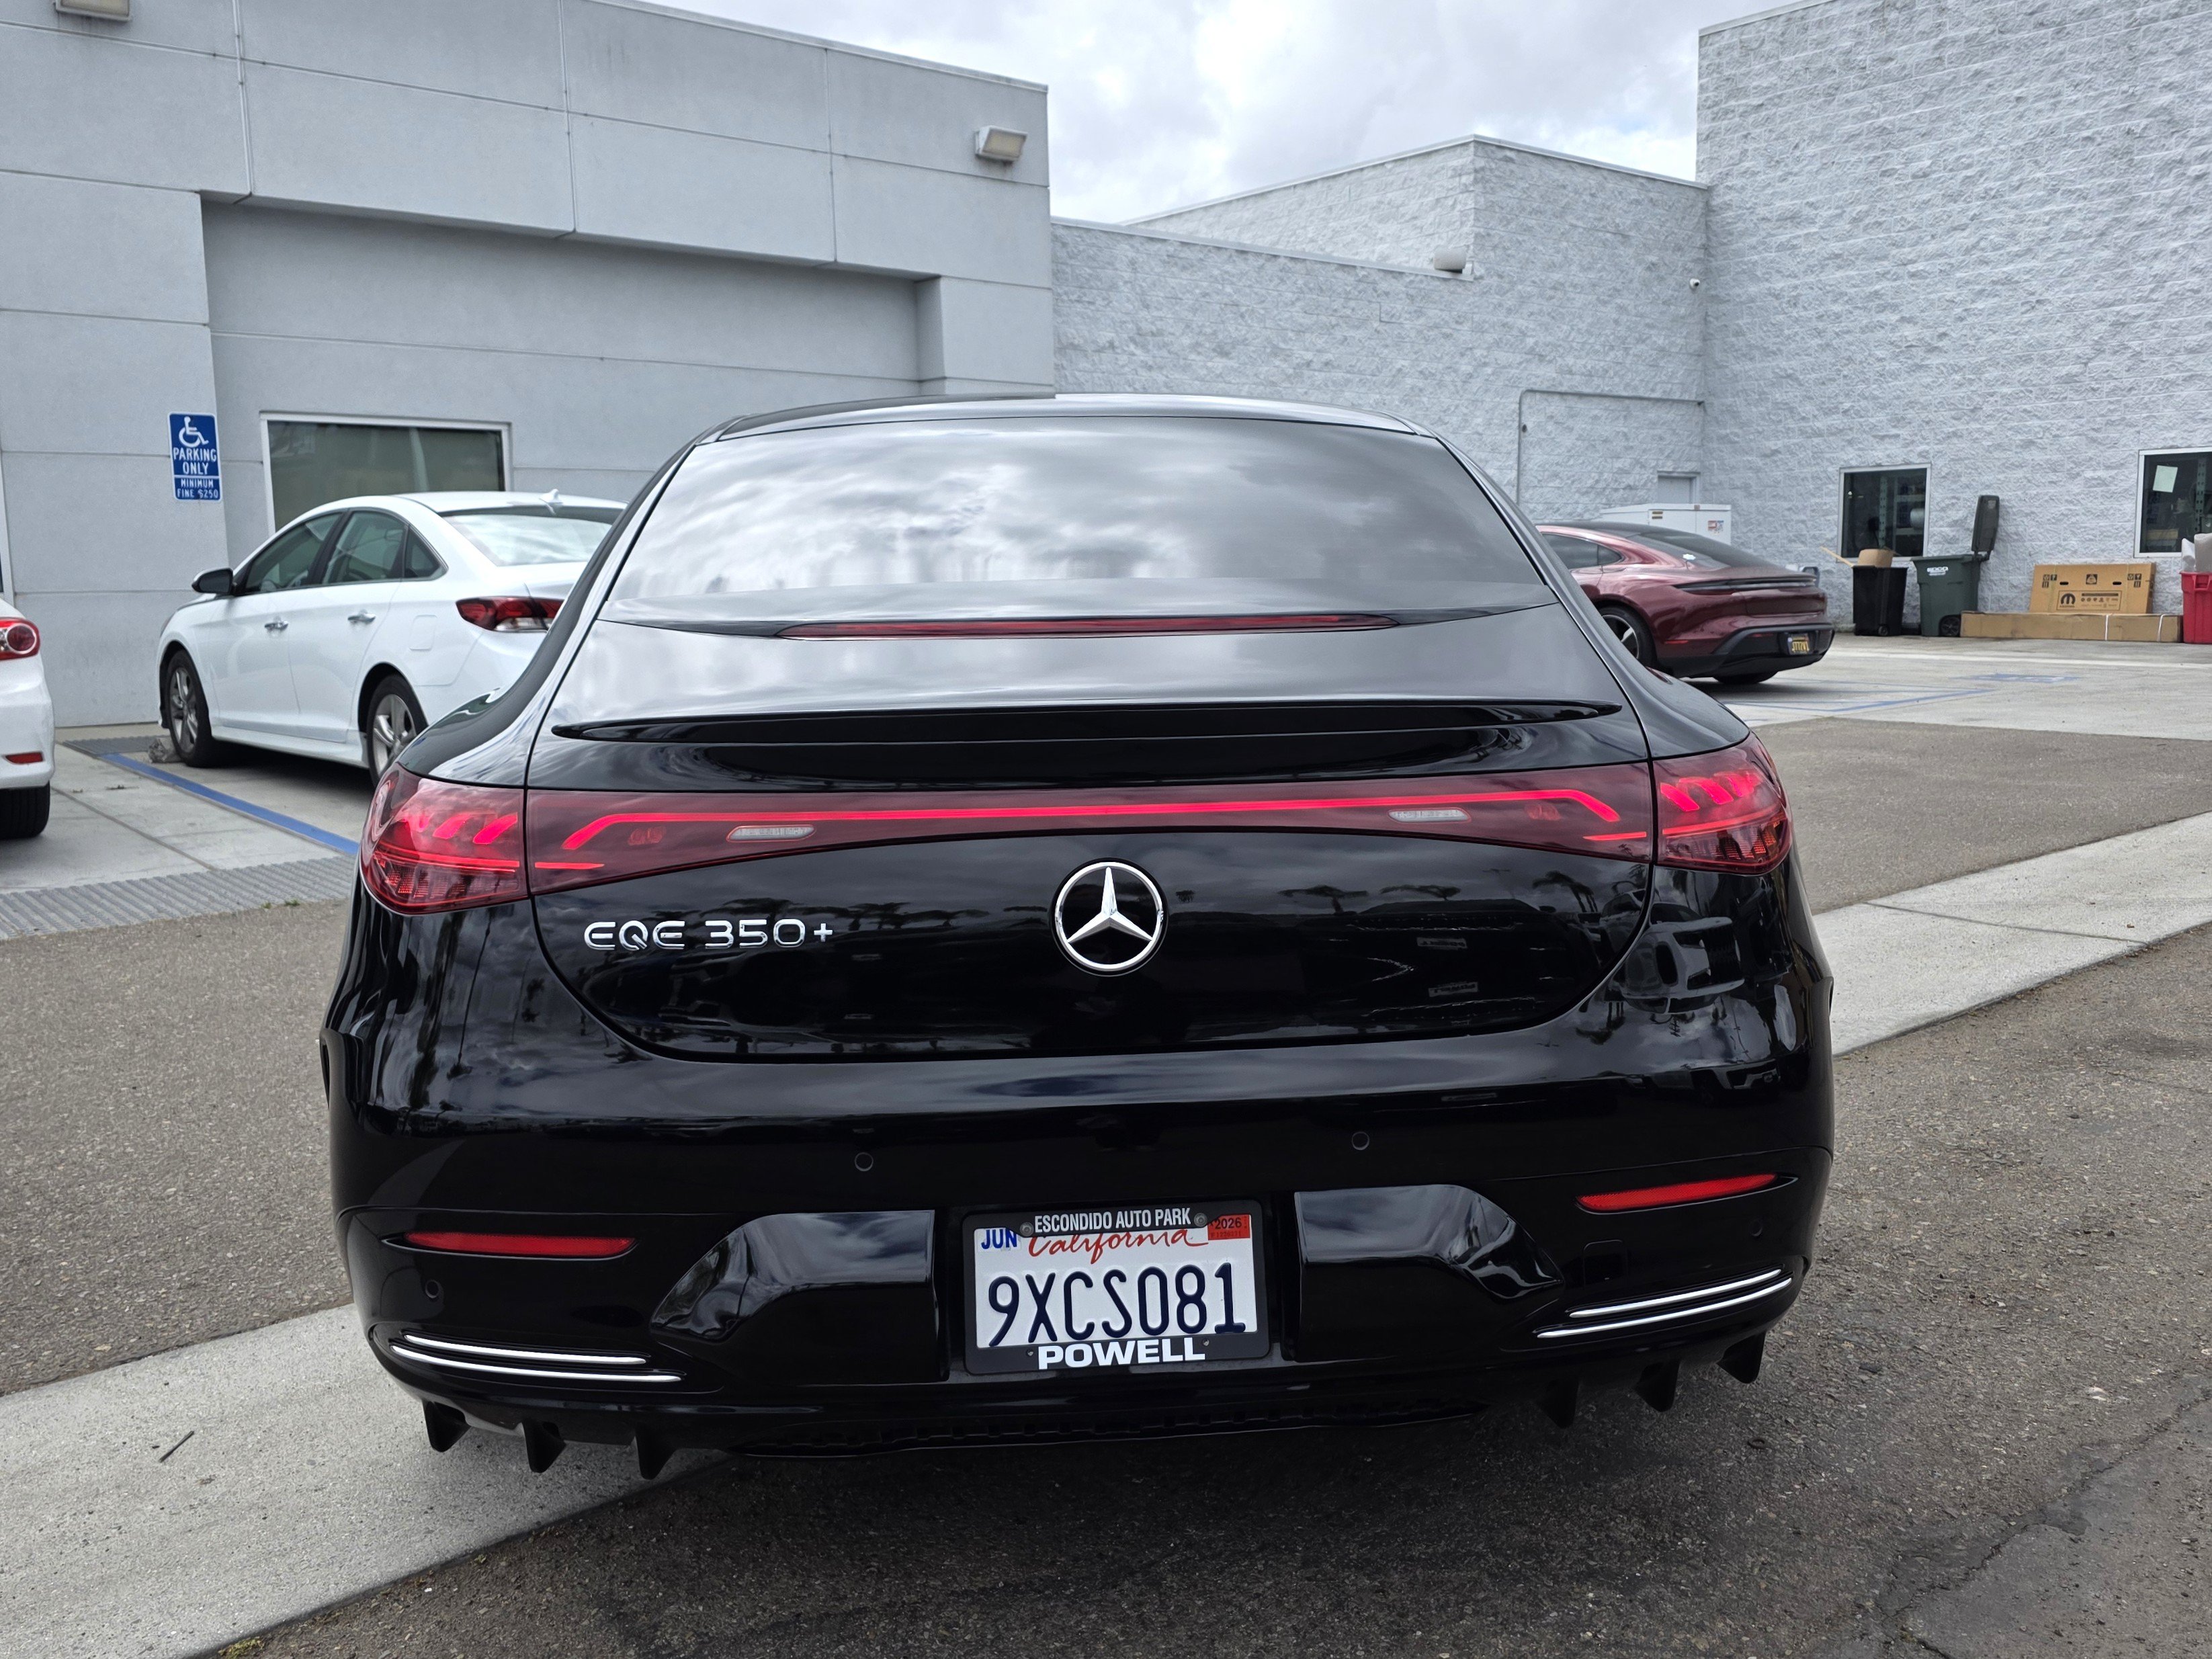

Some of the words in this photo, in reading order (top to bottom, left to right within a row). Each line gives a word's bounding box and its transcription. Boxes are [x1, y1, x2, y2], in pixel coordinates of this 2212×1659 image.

[173, 447, 217, 462] PARKING
[182, 462, 208, 475] ONLY
[181, 478, 214, 488] MINIMUM
[177, 488, 194, 497] FINE
[198, 488, 218, 499] $250
[584, 920, 685, 951] EQE
[705, 919, 833, 949] 350+
[1035, 1211, 1112, 1232] ESCONDIDO
[1115, 1209, 1151, 1229] AUTO
[1155, 1207, 1191, 1226] PARK
[1215, 1217, 1242, 1230] 2026
[981, 1229, 1017, 1249] JUN
[1028, 1229, 1209, 1265] California
[988, 1263, 1246, 1347] 9XCS081
[1038, 1337, 1205, 1369] POWELL
